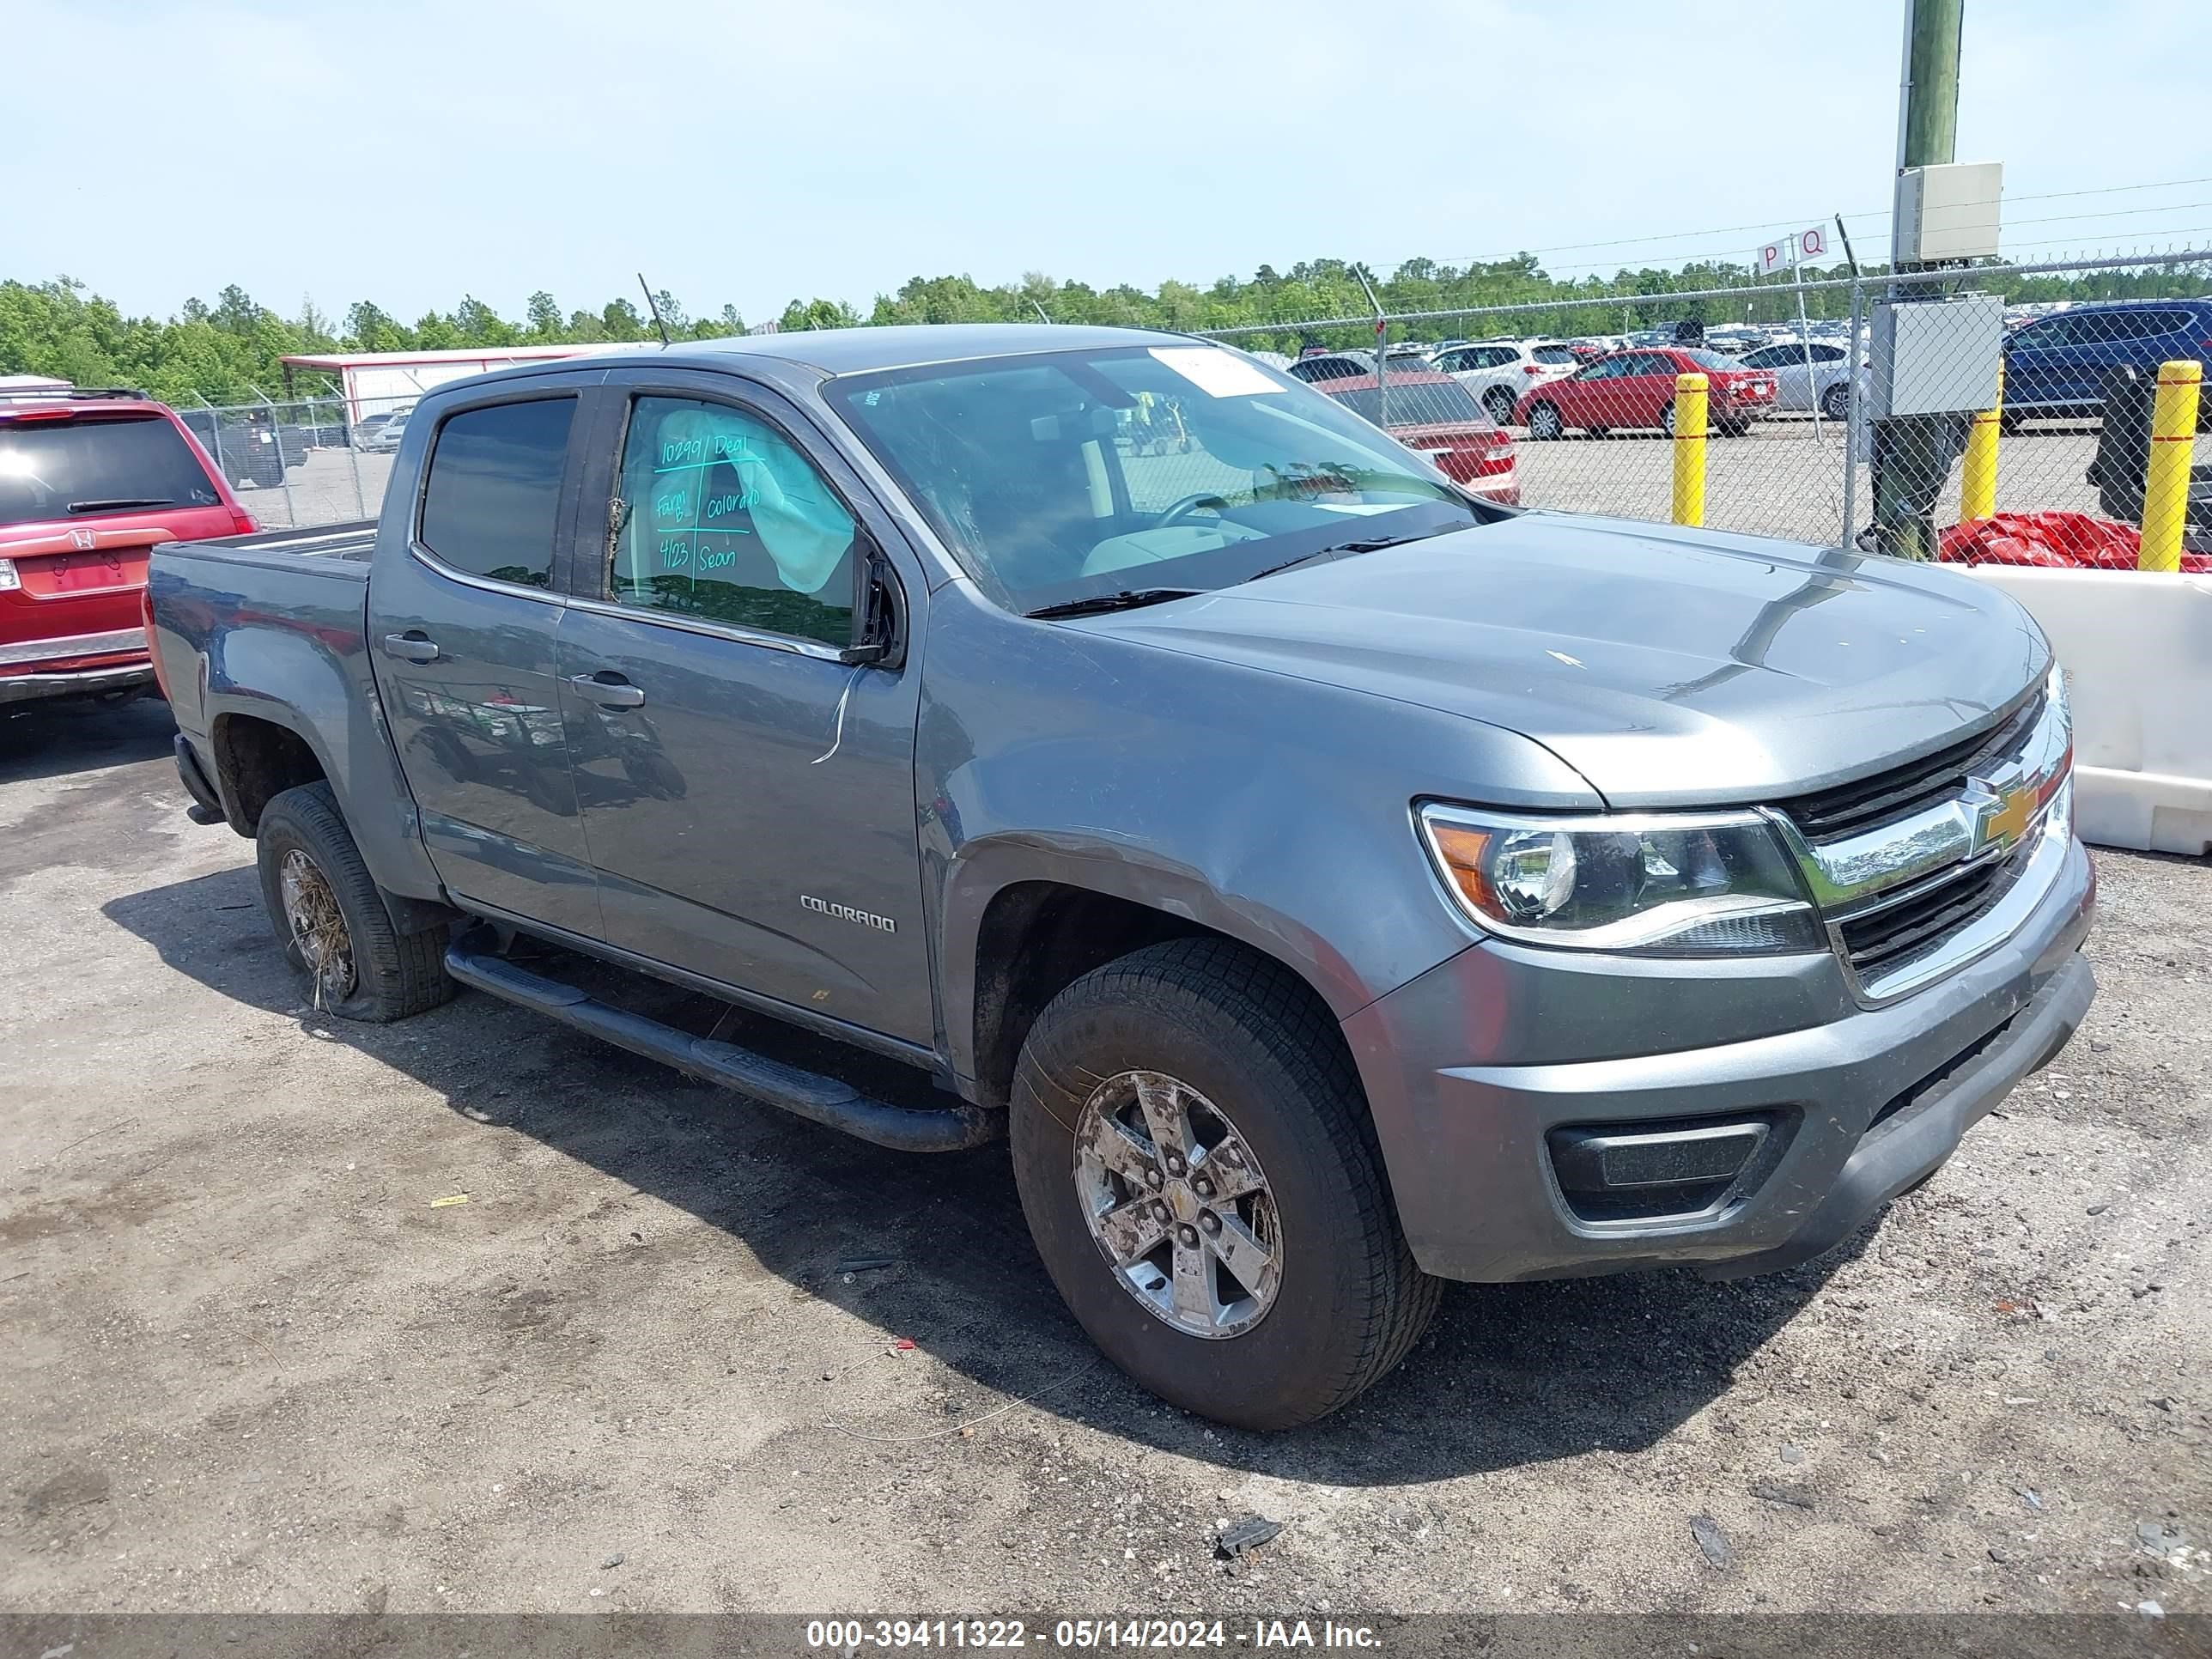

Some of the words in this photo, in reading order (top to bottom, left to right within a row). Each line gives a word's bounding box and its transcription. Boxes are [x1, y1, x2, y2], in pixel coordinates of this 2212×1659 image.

[1803, 230, 1824, 254] Q
[1765, 246, 1778, 270] P
[714, 433, 747, 454] Deal
[659, 538, 690, 568] 4/23
[699, 545, 736, 571] Sean
[799, 893, 896, 934] COLORADO
